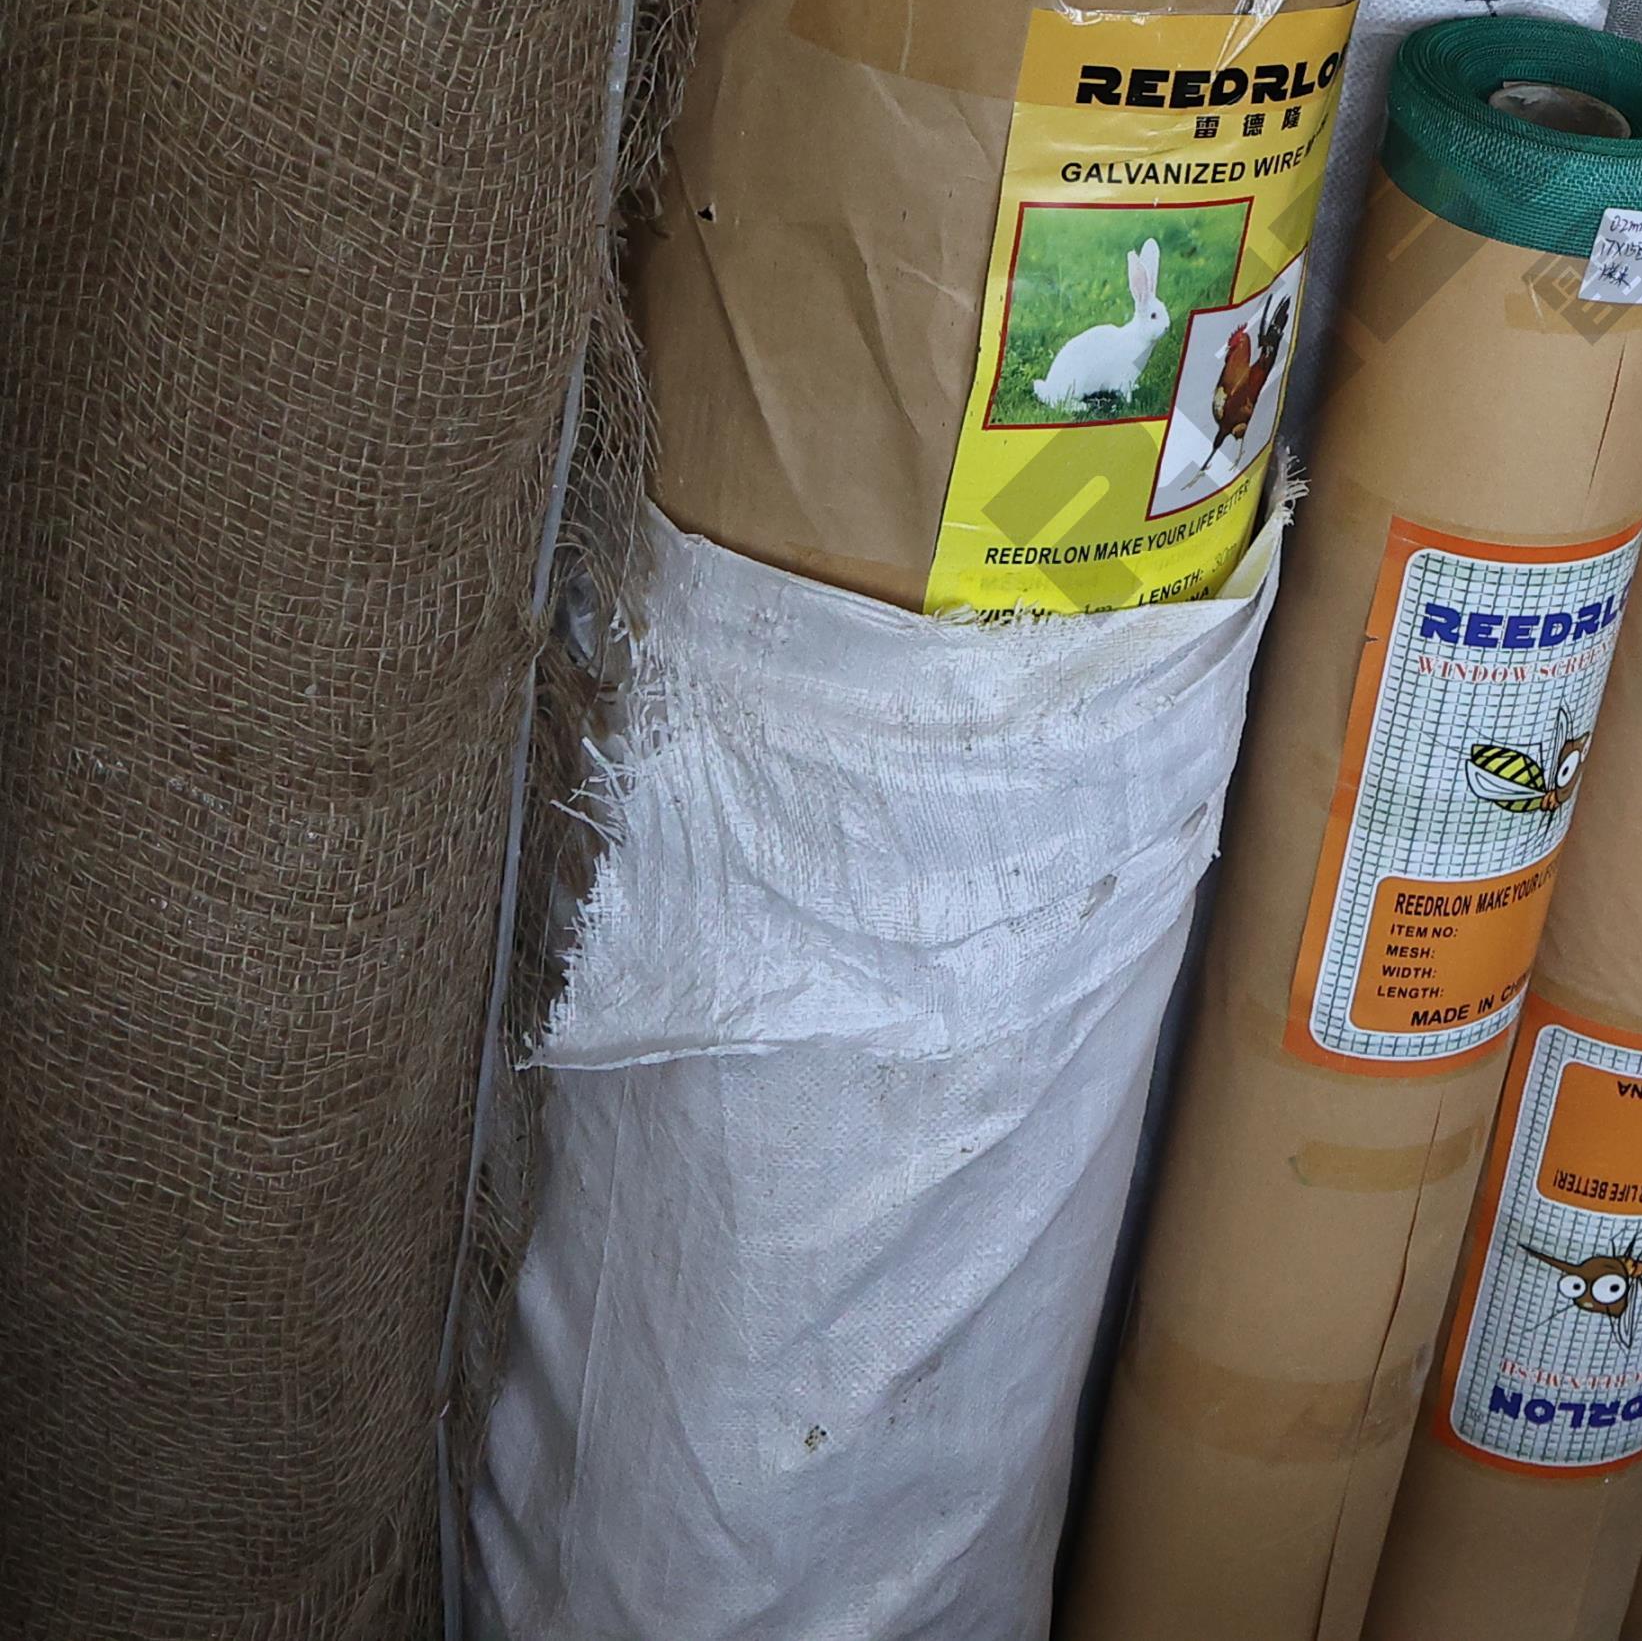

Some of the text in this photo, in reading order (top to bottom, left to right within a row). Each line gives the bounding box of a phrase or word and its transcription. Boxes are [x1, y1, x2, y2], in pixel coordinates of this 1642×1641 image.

[1061, 146, 1302, 185] GALVANIZED WIRE
[985, 545, 1091, 565] REEDRLON
[1093, 537, 1143, 562] MAKE
[1146, 524, 1188, 552] YOUR
[1187, 508, 1215, 539] LIFE
[1420, 588, 1629, 650] REEDRL
[1417, 655, 1529, 683] WINDOW
[1394, 892, 1473, 917] REEDRLON
[1476, 886, 1511, 915] MAKE
[1390, 923, 1459, 939] ITEM NO:
[1386, 944, 1436, 959] MESH:
[1382, 965, 1437, 979] WIDTH:
[1377, 985, 1444, 999] LENGTH:
[1410, 1004, 1471, 1027] MADE
[1477, 995, 1495, 1014] IN
[1552, 1169, 1608, 1201] BETTER!
[1608, 1181, 1639, 1204] LIFE
